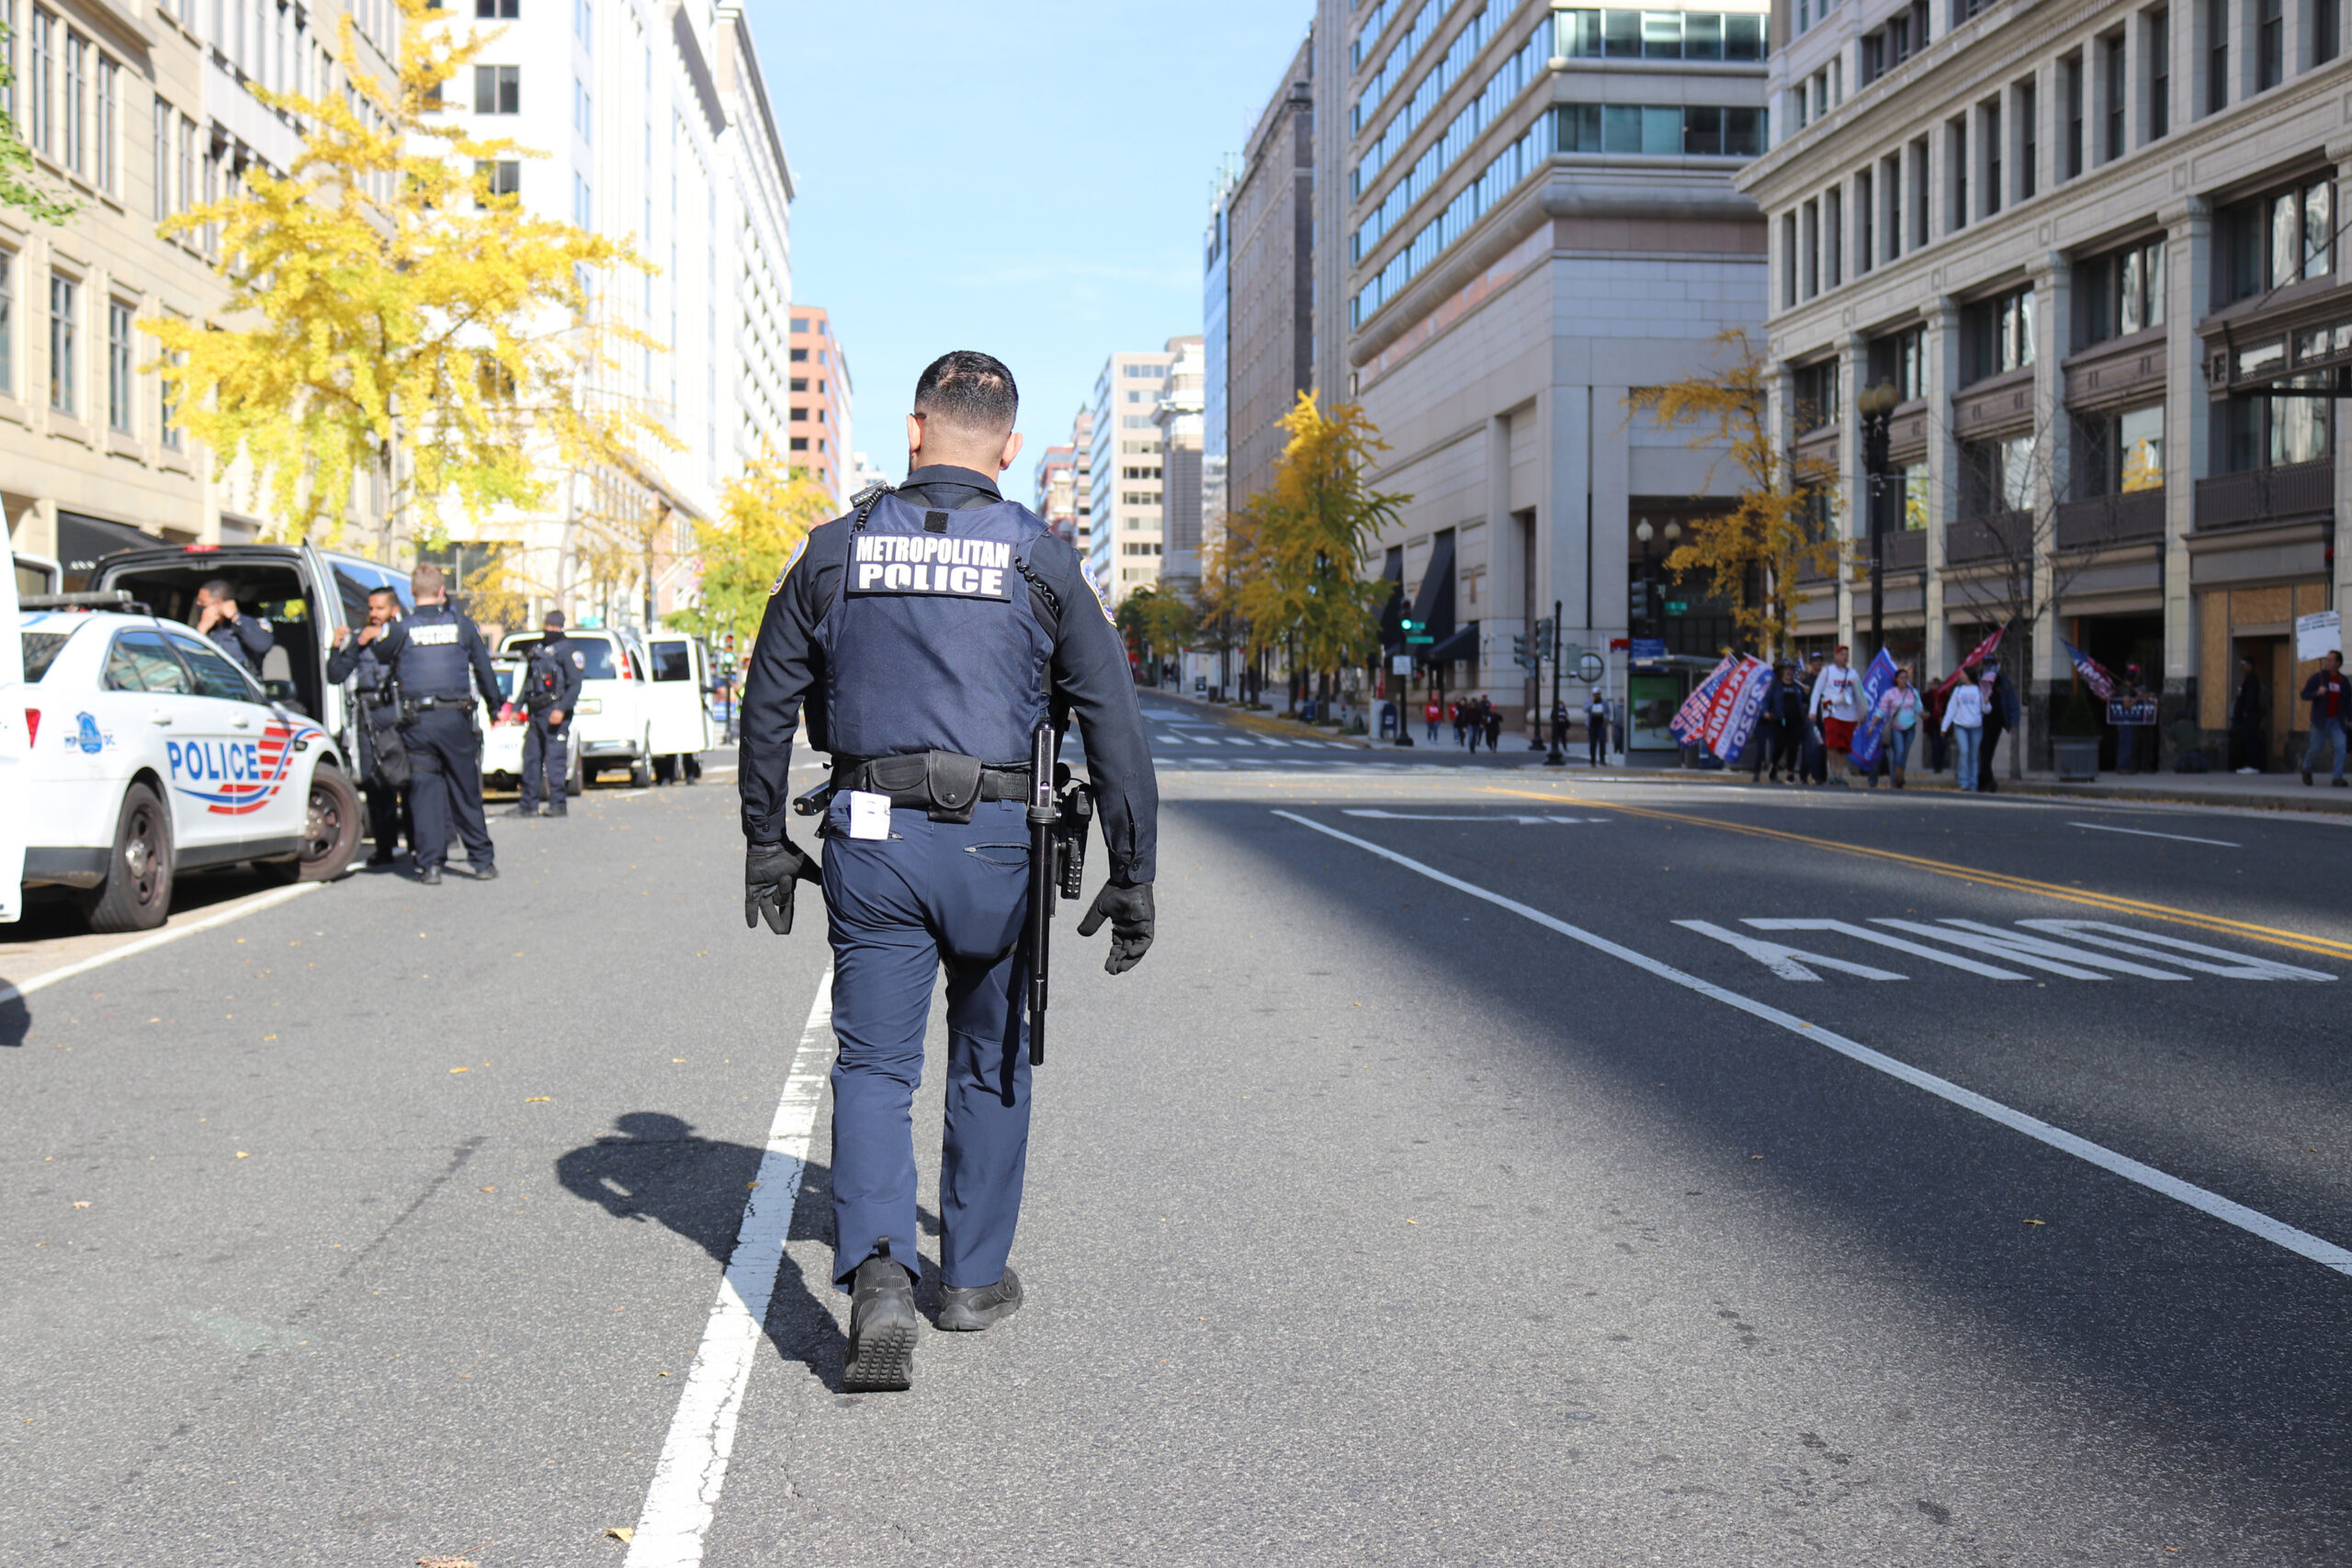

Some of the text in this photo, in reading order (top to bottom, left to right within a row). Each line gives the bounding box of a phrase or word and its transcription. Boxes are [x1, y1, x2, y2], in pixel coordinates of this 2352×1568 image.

[856, 536, 1011, 569] METROPOLITAN
[858, 563, 1003, 595] POLICE
[165, 740, 260, 780] POLICE
